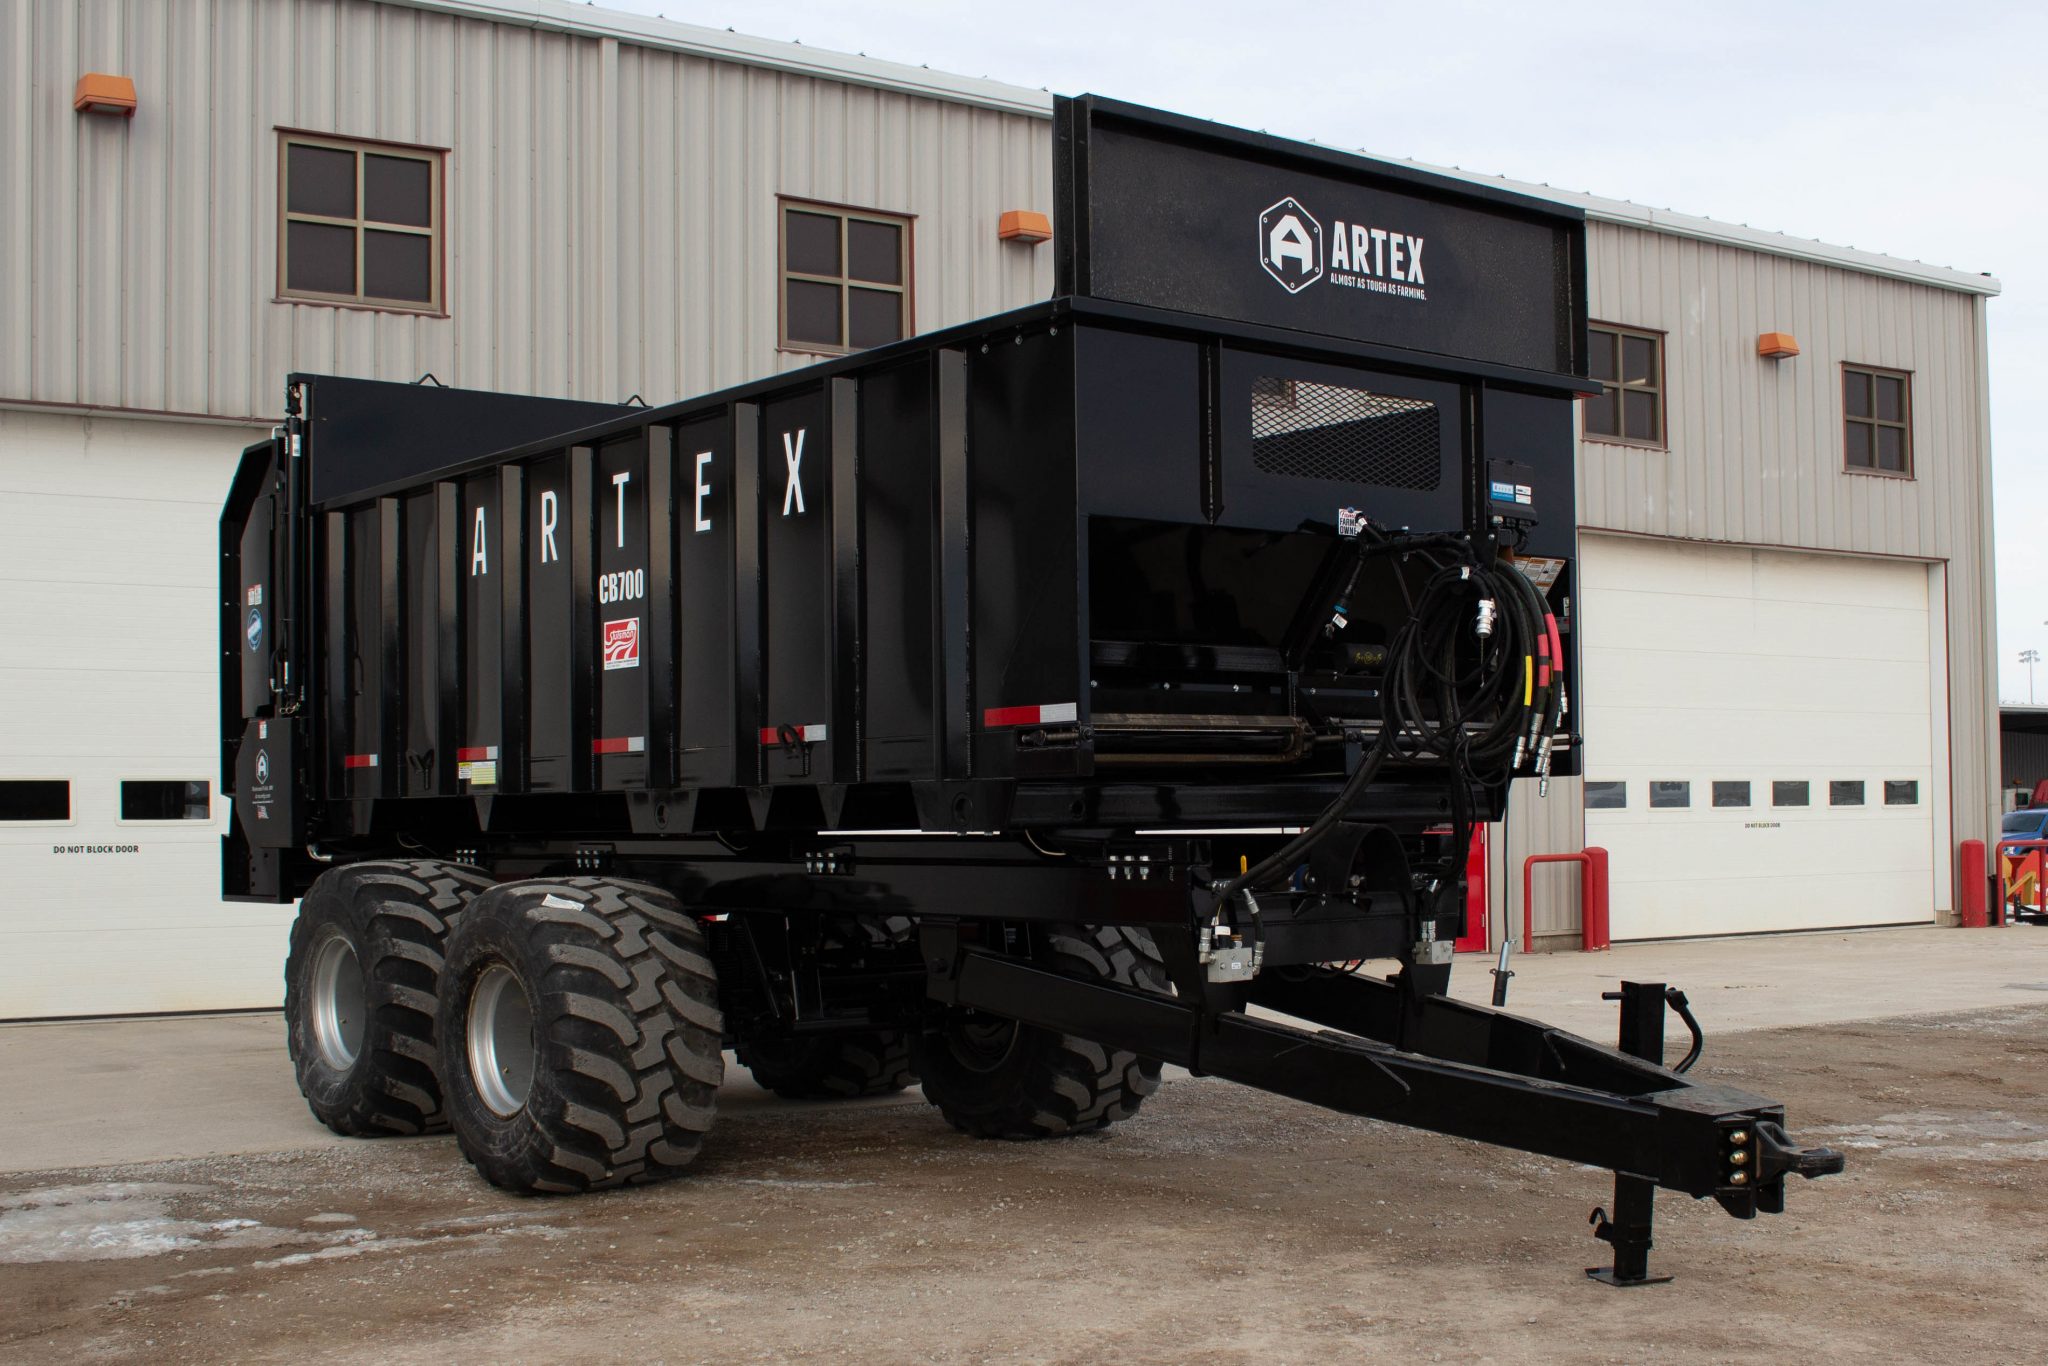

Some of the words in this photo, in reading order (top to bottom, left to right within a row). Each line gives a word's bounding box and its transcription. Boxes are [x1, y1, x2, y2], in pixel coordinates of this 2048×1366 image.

[1331, 220, 1425, 285] ARTEX
[1330, 272, 1355, 288] ALMOST
[1356, 277, 1366, 289] AS
[1366, 279, 1387, 294] TOUGH
[1388, 284, 1397, 295] AS
[1397, 286, 1427, 301] FARMING.
[599, 568, 644, 605] CB700
[53, 845, 65, 854] DO
[67, 845, 85, 854] NOT
[86, 845, 113, 854] BLOCK
[115, 845, 139, 854] DOOR
